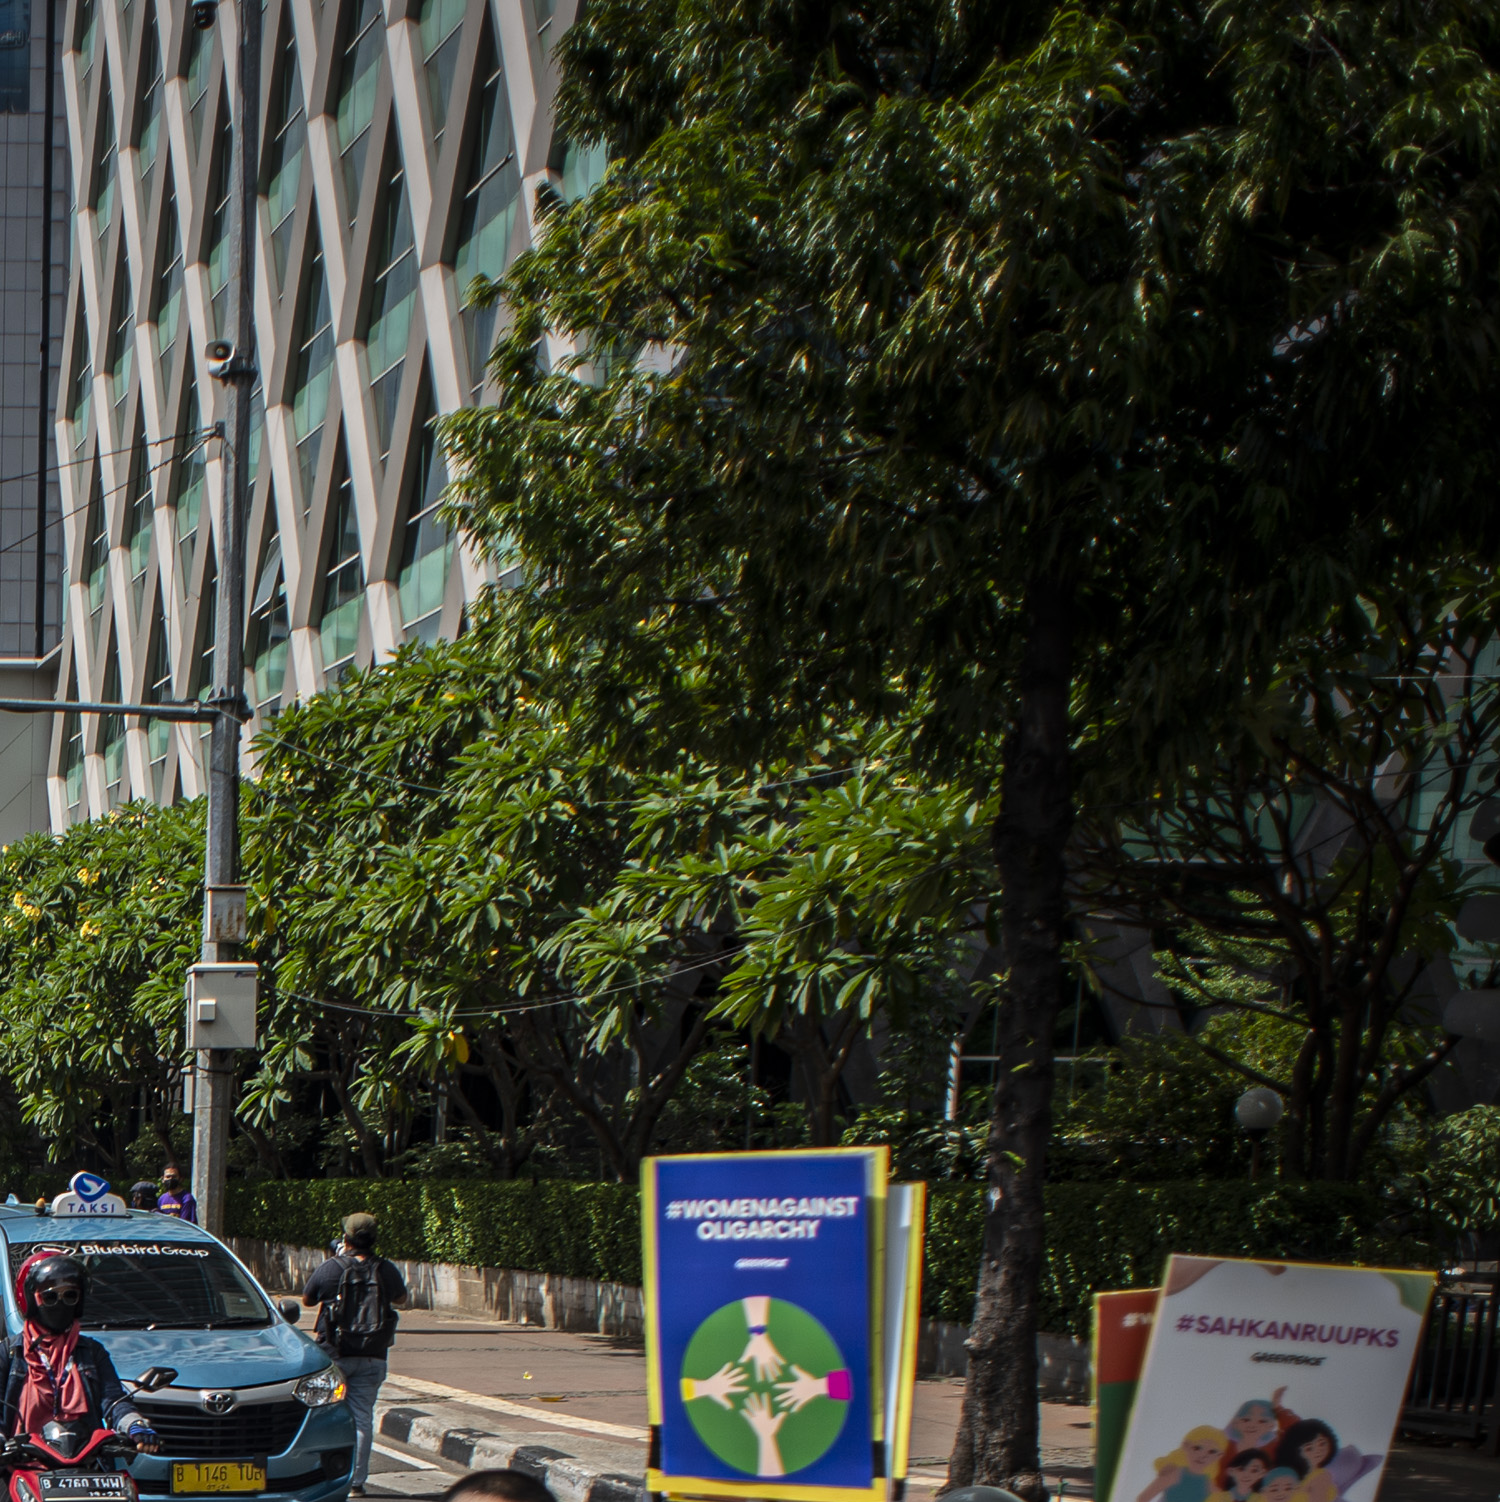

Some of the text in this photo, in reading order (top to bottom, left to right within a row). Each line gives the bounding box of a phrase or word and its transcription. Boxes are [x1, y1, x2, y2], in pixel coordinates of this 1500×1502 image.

[68, 1203, 115, 1213] TAKSI
[665, 1197, 859, 1219] #WOMENAGAINST
[697, 1220, 820, 1240] OLIGARCHY
[81, 1244, 209, 1258] Bluebird Group
[1175, 1313, 1399, 1348] #SAHKANRUUPKS
[176, 1467, 184, 1482] B
[195, 1465, 227, 1482] 1146
[43, 1479, 51, 1489] B
[93, 1478, 119, 1488] TWW
